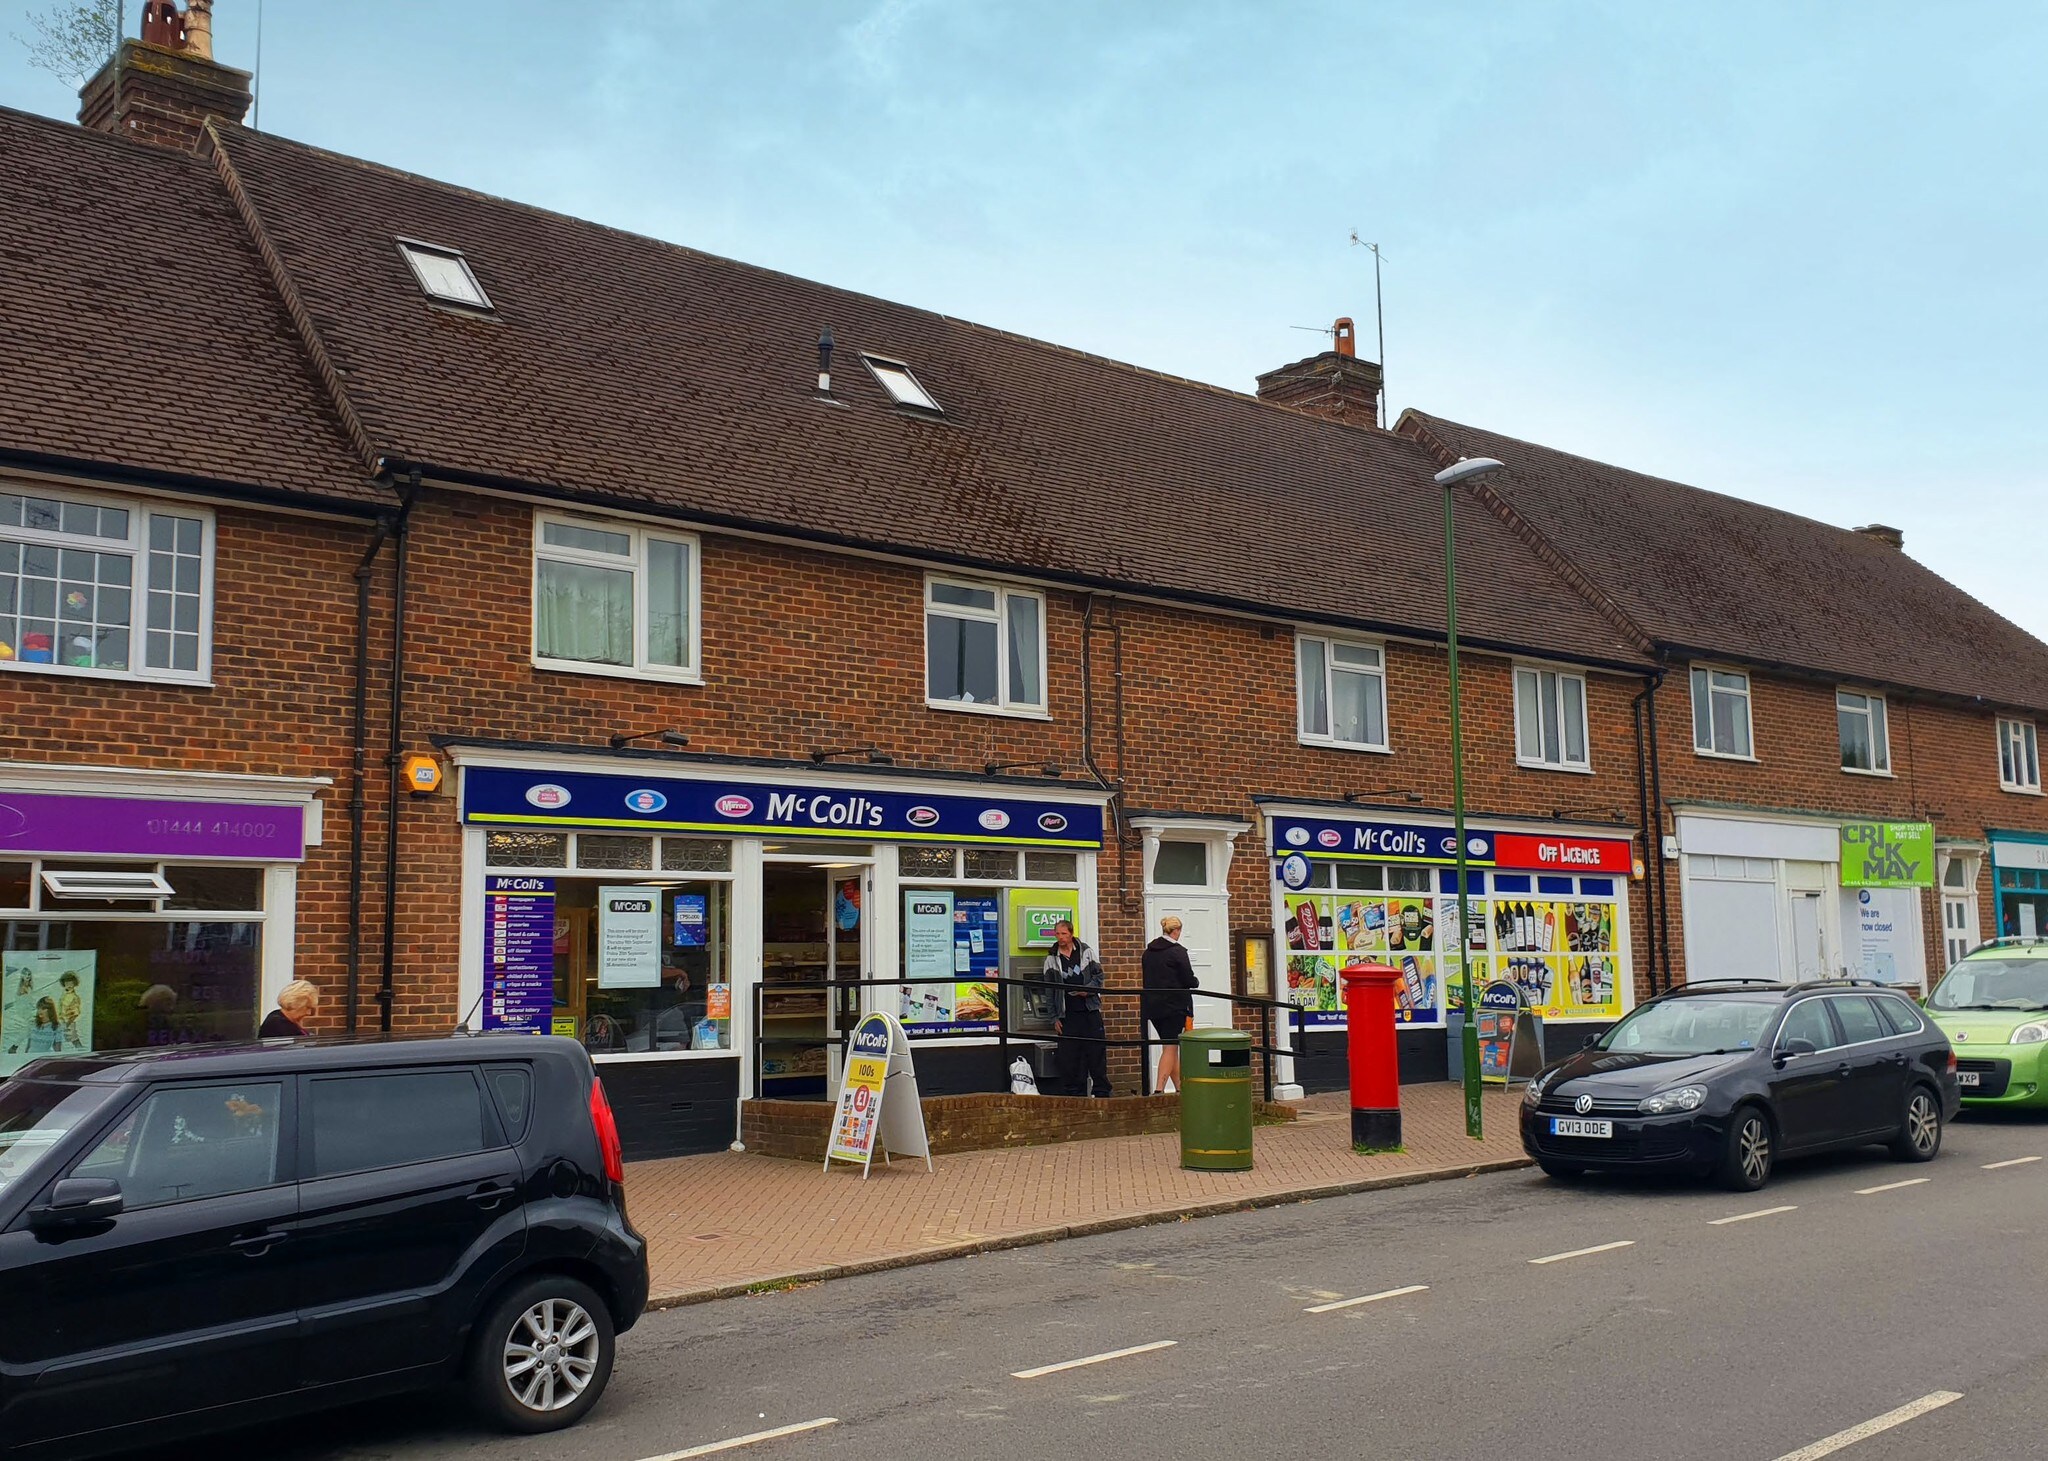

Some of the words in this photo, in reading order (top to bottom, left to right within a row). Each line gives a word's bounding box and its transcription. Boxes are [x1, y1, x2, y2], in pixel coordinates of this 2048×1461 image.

[416, 767, 434, 781] ADT
[722, 800, 748, 810] Mirror
[765, 792, 884, 827] McColl's
[1353, 827, 1426, 854] McColl's
[1863, 861, 1920, 880] MAY
[496, 878, 545, 890] McColl's
[614, 901, 647, 911] McColl's
[917, 904, 943, 914] McColl's
[1031, 913, 1065, 925] CASH
[1860, 908, 1870, 918] We
[1870, 910, 1880, 918] are
[1861, 923, 1874, 932] now
[1874, 922, 1893, 932] closed
[1290, 994, 1296, 1005] 5
[1303, 996, 1316, 1007] DAY
[1483, 993, 1516, 1005] McColl's
[857, 1032, 888, 1048] McColl's
[858, 1064, 875, 1077] 100s
[856, 1090, 868, 1107] £1
[1558, 1121, 1582, 1133] GV13
[1584, 1122, 1607, 1135] ODE
